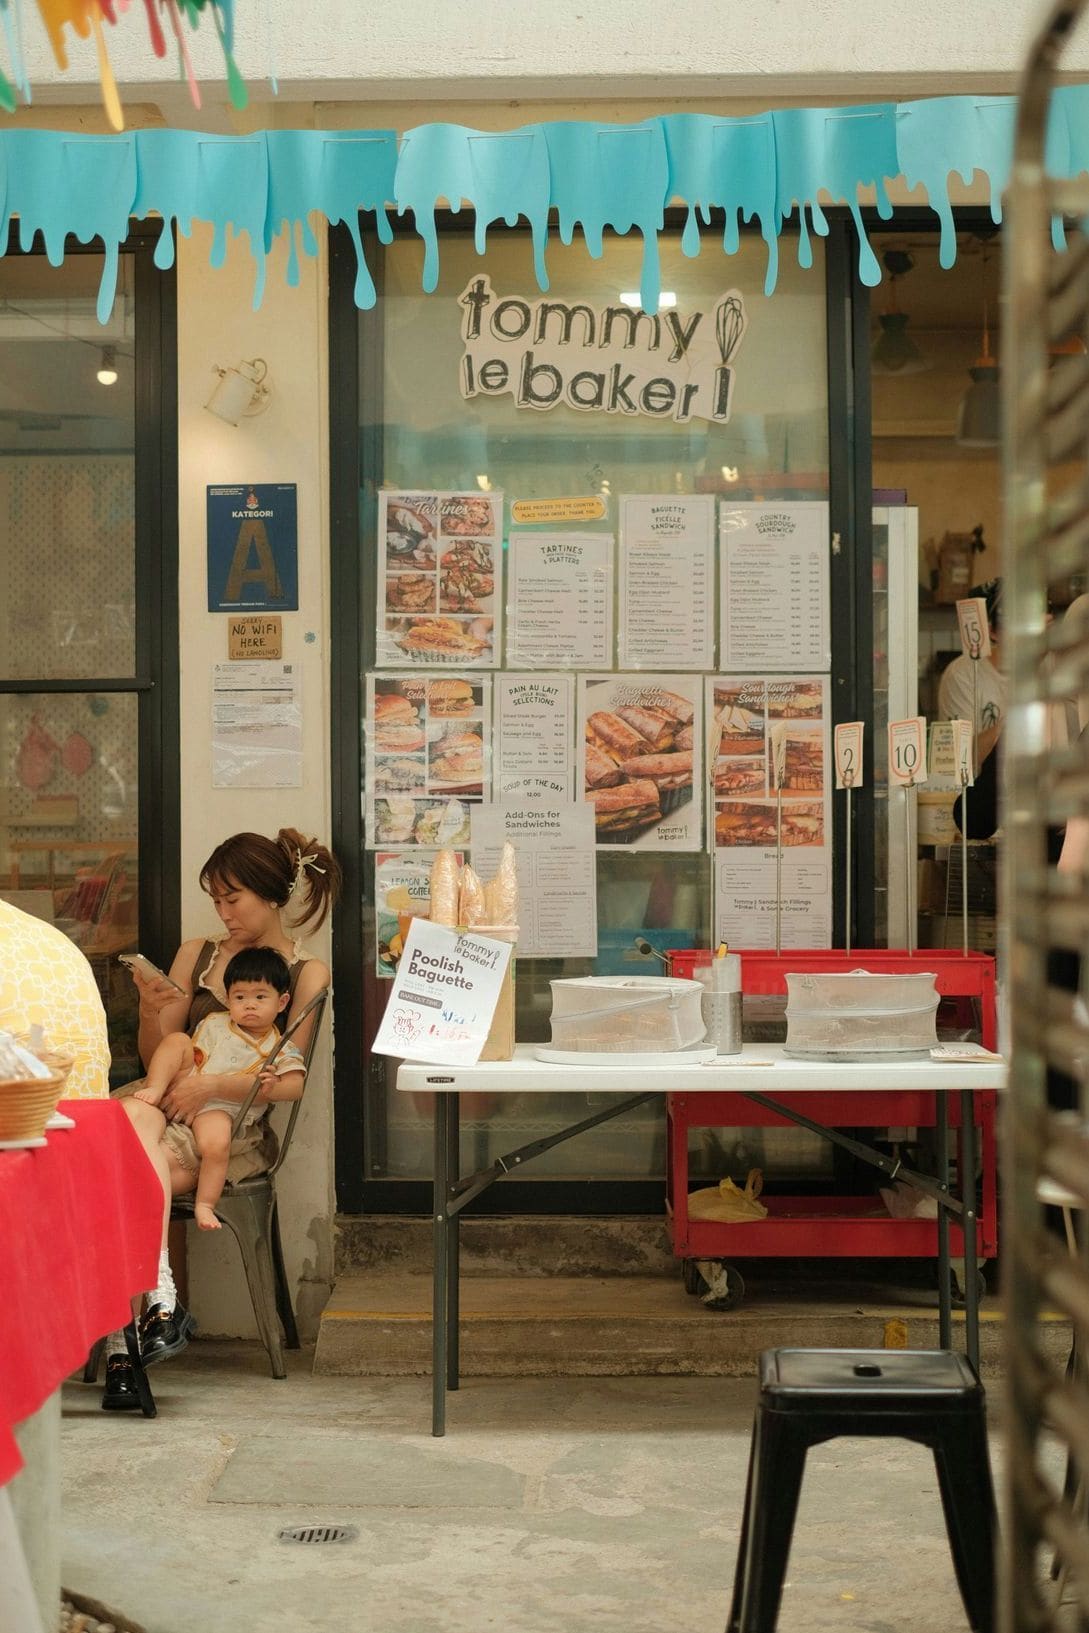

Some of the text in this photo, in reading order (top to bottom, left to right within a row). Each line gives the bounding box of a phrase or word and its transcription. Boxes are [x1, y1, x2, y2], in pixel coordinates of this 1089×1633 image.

[462, 279, 703, 363] tommy
[463, 350, 699, 420] le baker
[232, 510, 274, 518] KATEGORI
[652, 506, 686, 514] BAGUETTE
[760, 514, 791, 522] COUNTRY
[650, 522, 686, 530] SANDWICH
[755, 520, 796, 528] SOURDOUGH
[540, 544, 584, 555] TARTINES
[222, 519, 286, 602] A
[549, 556, 580, 565] PLATTERS
[232, 624, 276, 636] NO WIFI
[964, 622, 981, 644] 15
[240, 638, 266, 648] HERE
[508, 686, 526, 696] PAIN
[542, 686, 559, 696] LAIT
[512, 696, 555, 706] SELECTIONS
[844, 748, 854, 772] 2
[894, 744, 916, 768] 10
[503, 781, 521, 793] SOUP
[535, 779, 549, 787] THE
[550, 782, 564, 793] DAY
[505, 810, 560, 819] Add-Ons for
[505, 820, 561, 829] Sandwiches
[392, 878, 420, 886] LEMON
[412, 948, 464, 974] Poolish
[462, 950, 490, 969] baker
[408, 962, 474, 990] Baguette
